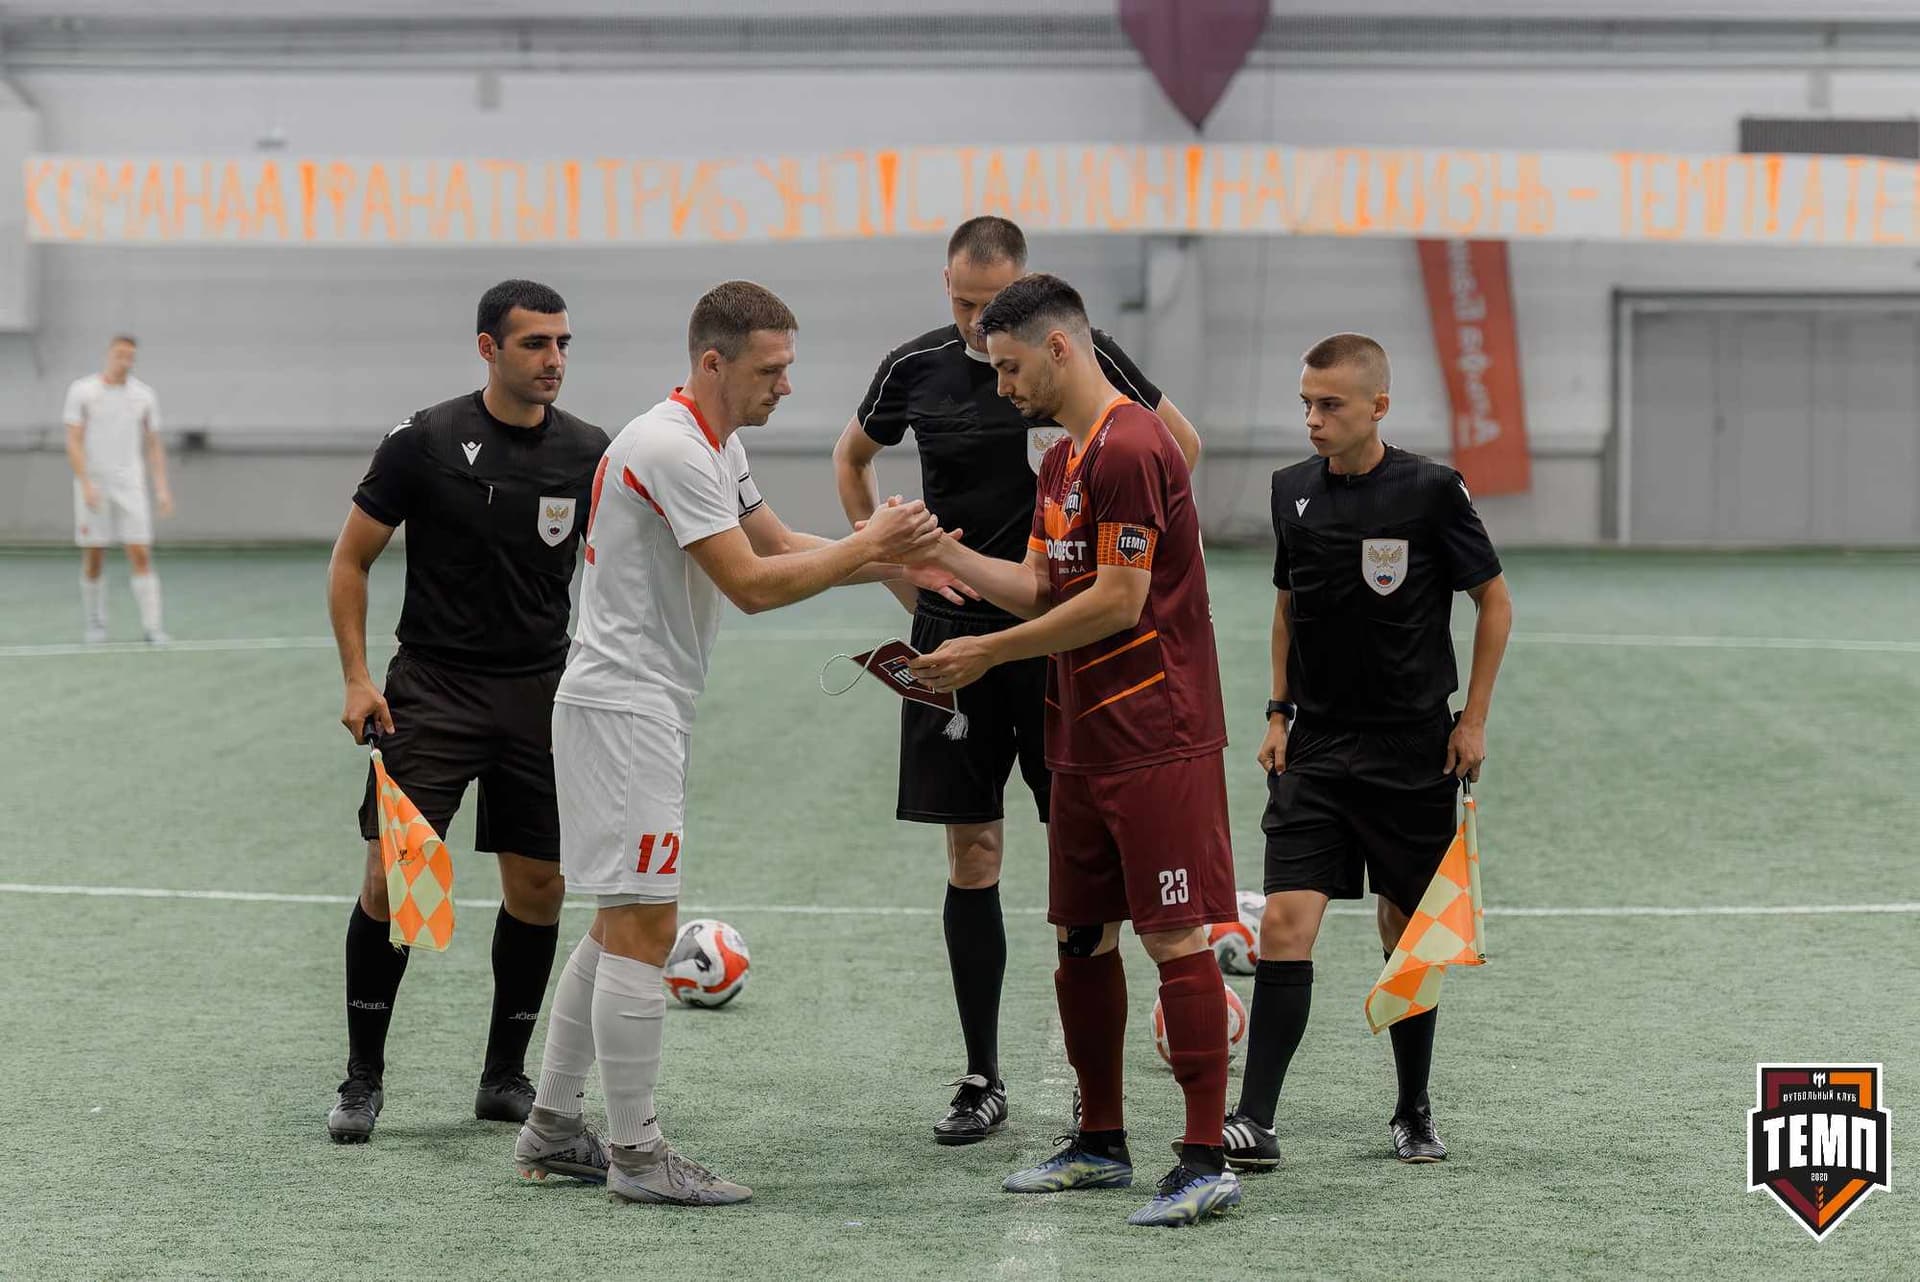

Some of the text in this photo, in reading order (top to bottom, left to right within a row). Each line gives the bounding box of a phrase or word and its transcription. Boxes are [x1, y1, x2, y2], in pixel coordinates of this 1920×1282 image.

[1120, 536, 1146, 552] ТЕМП
[636, 832, 680, 875] 12
[1158, 868, 1189, 906] 23
